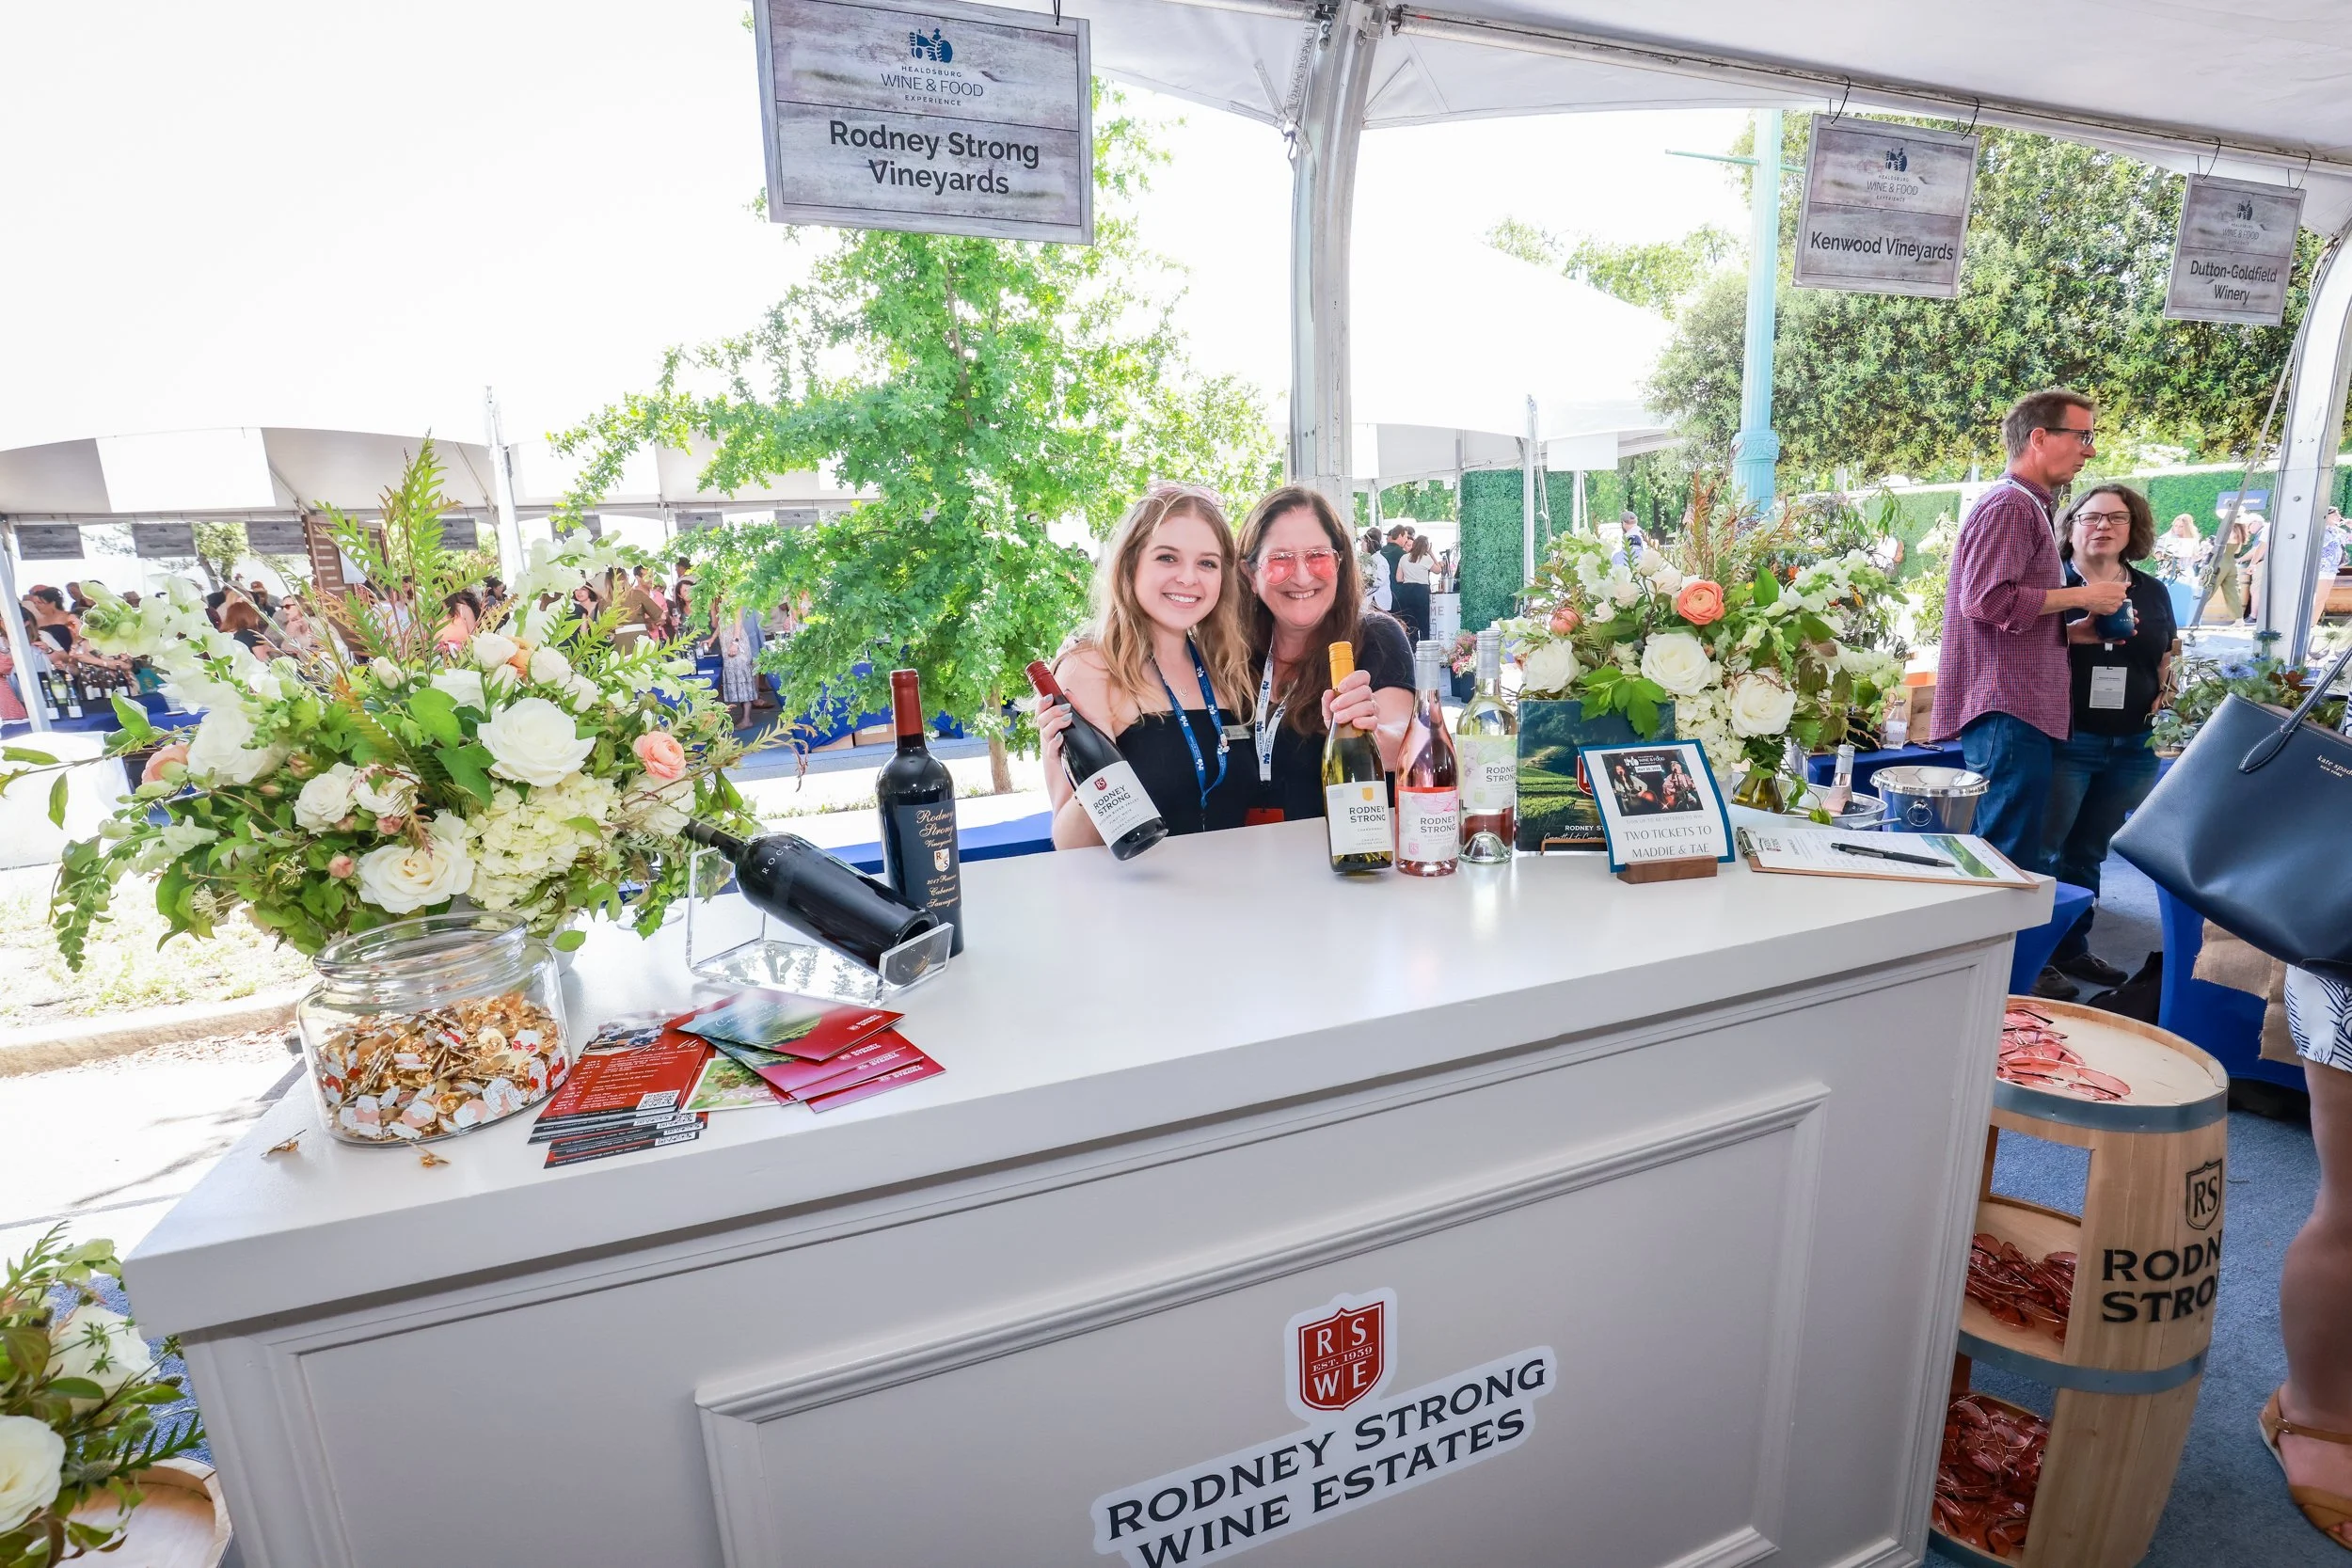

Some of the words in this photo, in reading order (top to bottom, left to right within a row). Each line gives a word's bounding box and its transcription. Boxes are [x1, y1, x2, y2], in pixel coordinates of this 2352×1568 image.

[901, 65, 962, 78] HEALDSBURG
[881, 73, 923, 92] WINE
[926, 79, 937, 92] &
[941, 80, 984, 97] FOOD
[904, 94, 961, 106] EXPERIENCE
[830, 119, 940, 160] Rodney
[948, 132, 1040, 169] Strong
[868, 159, 1009, 196] Vineyards
[1867, 181, 1887, 192] WINE
[1888, 183, 1895, 192] &
[1896, 184, 1918, 196] FOOD
[1810, 231, 1883, 254] Kenwood
[1885, 237, 1954, 262] Vineyards
[2190, 260, 2278, 283] Dutton-Goldfield
[2214, 284, 2250, 306] Winery
[2317, 755, 2333, 766] kate
[1095, 777, 1105, 789] RS
[1093, 784, 1126, 810] RODNEY
[1097, 792, 1131, 816] STRONG
[916, 809, 954, 824] Rodney
[1349, 806, 1385, 815] RODNEY
[1350, 815, 1386, 823] STRONG
[919, 823, 953, 837] Strong
[1421, 816, 1455, 825] RODNEY
[1421, 824, 1455, 832] STRONG
[1624, 830, 1649, 841] TWO
[1651, 827, 1694, 839] TICKETS
[1696, 825, 1712, 835] TO
[936, 851, 942, 861] R
[1632, 846, 1675, 858] MADDIE
[1678, 846, 1686, 855] &
[1690, 843, 1709, 854] TAE
[677, 1039, 698, 1049] Us
[2193, 1176, 2217, 1218] RS
[2102, 1229, 2222, 1281] RODN
[1317, 1327, 1334, 1357] R
[1351, 1317, 1367, 1346] S
[1312, 1358, 1339, 1371] EST.
[1344, 1346, 1373, 1362] 1959
[1313, 1370, 1340, 1401] W
[1353, 1360, 1367, 1388] E
[1107, 1432, 1335, 1541] RODNEY
[1355, 1358, 1546, 1451] STRONG
[1136, 1494, 1291, 1568] WINE
[1311, 1408, 1525, 1513] ESTATES
